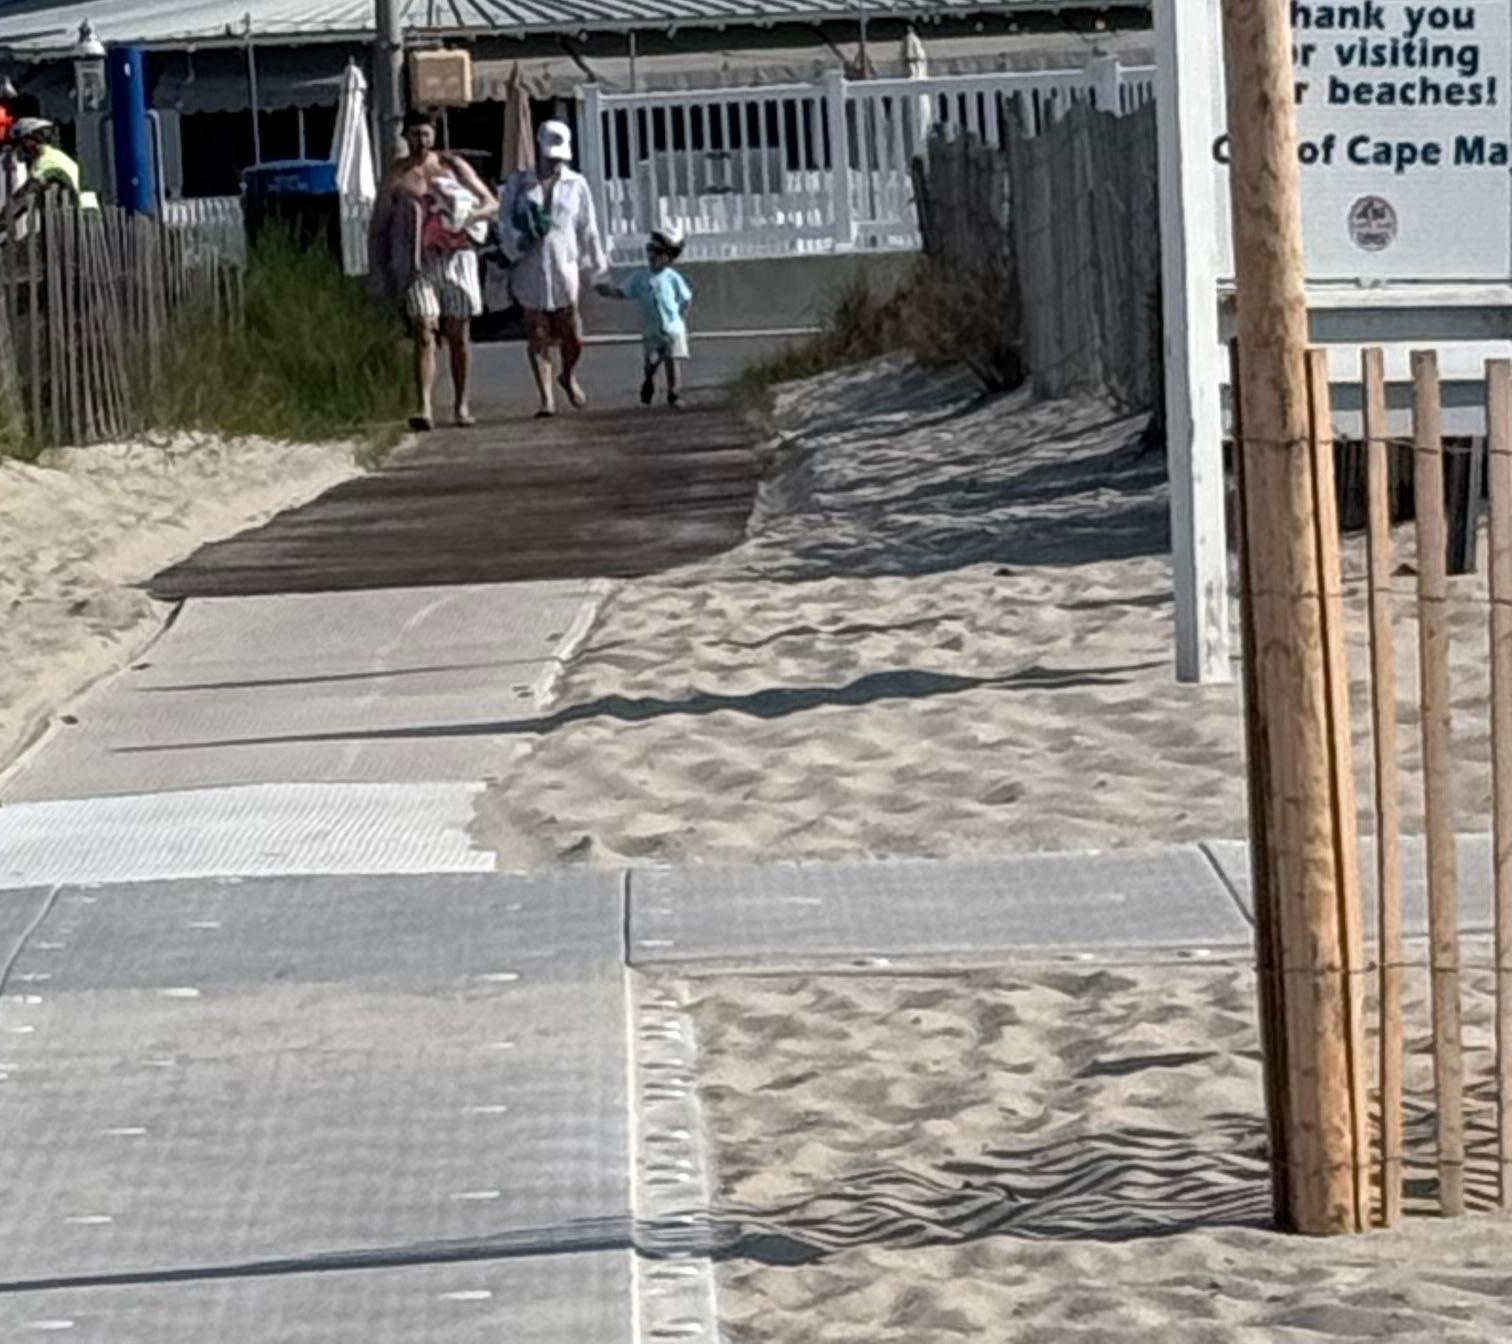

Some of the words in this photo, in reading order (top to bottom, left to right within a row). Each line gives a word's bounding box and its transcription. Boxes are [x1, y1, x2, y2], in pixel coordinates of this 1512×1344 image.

[1290, 0, 1385, 31] hank
[1403, 6, 1476, 40] you
[1335, 37, 1480, 78] visiting
[1327, 75, 1498, 107] beaches!
[1297, 133, 1336, 166] of
[1346, 134, 1442, 176] Cape
[1453, 134, 1512, 176] Ma
